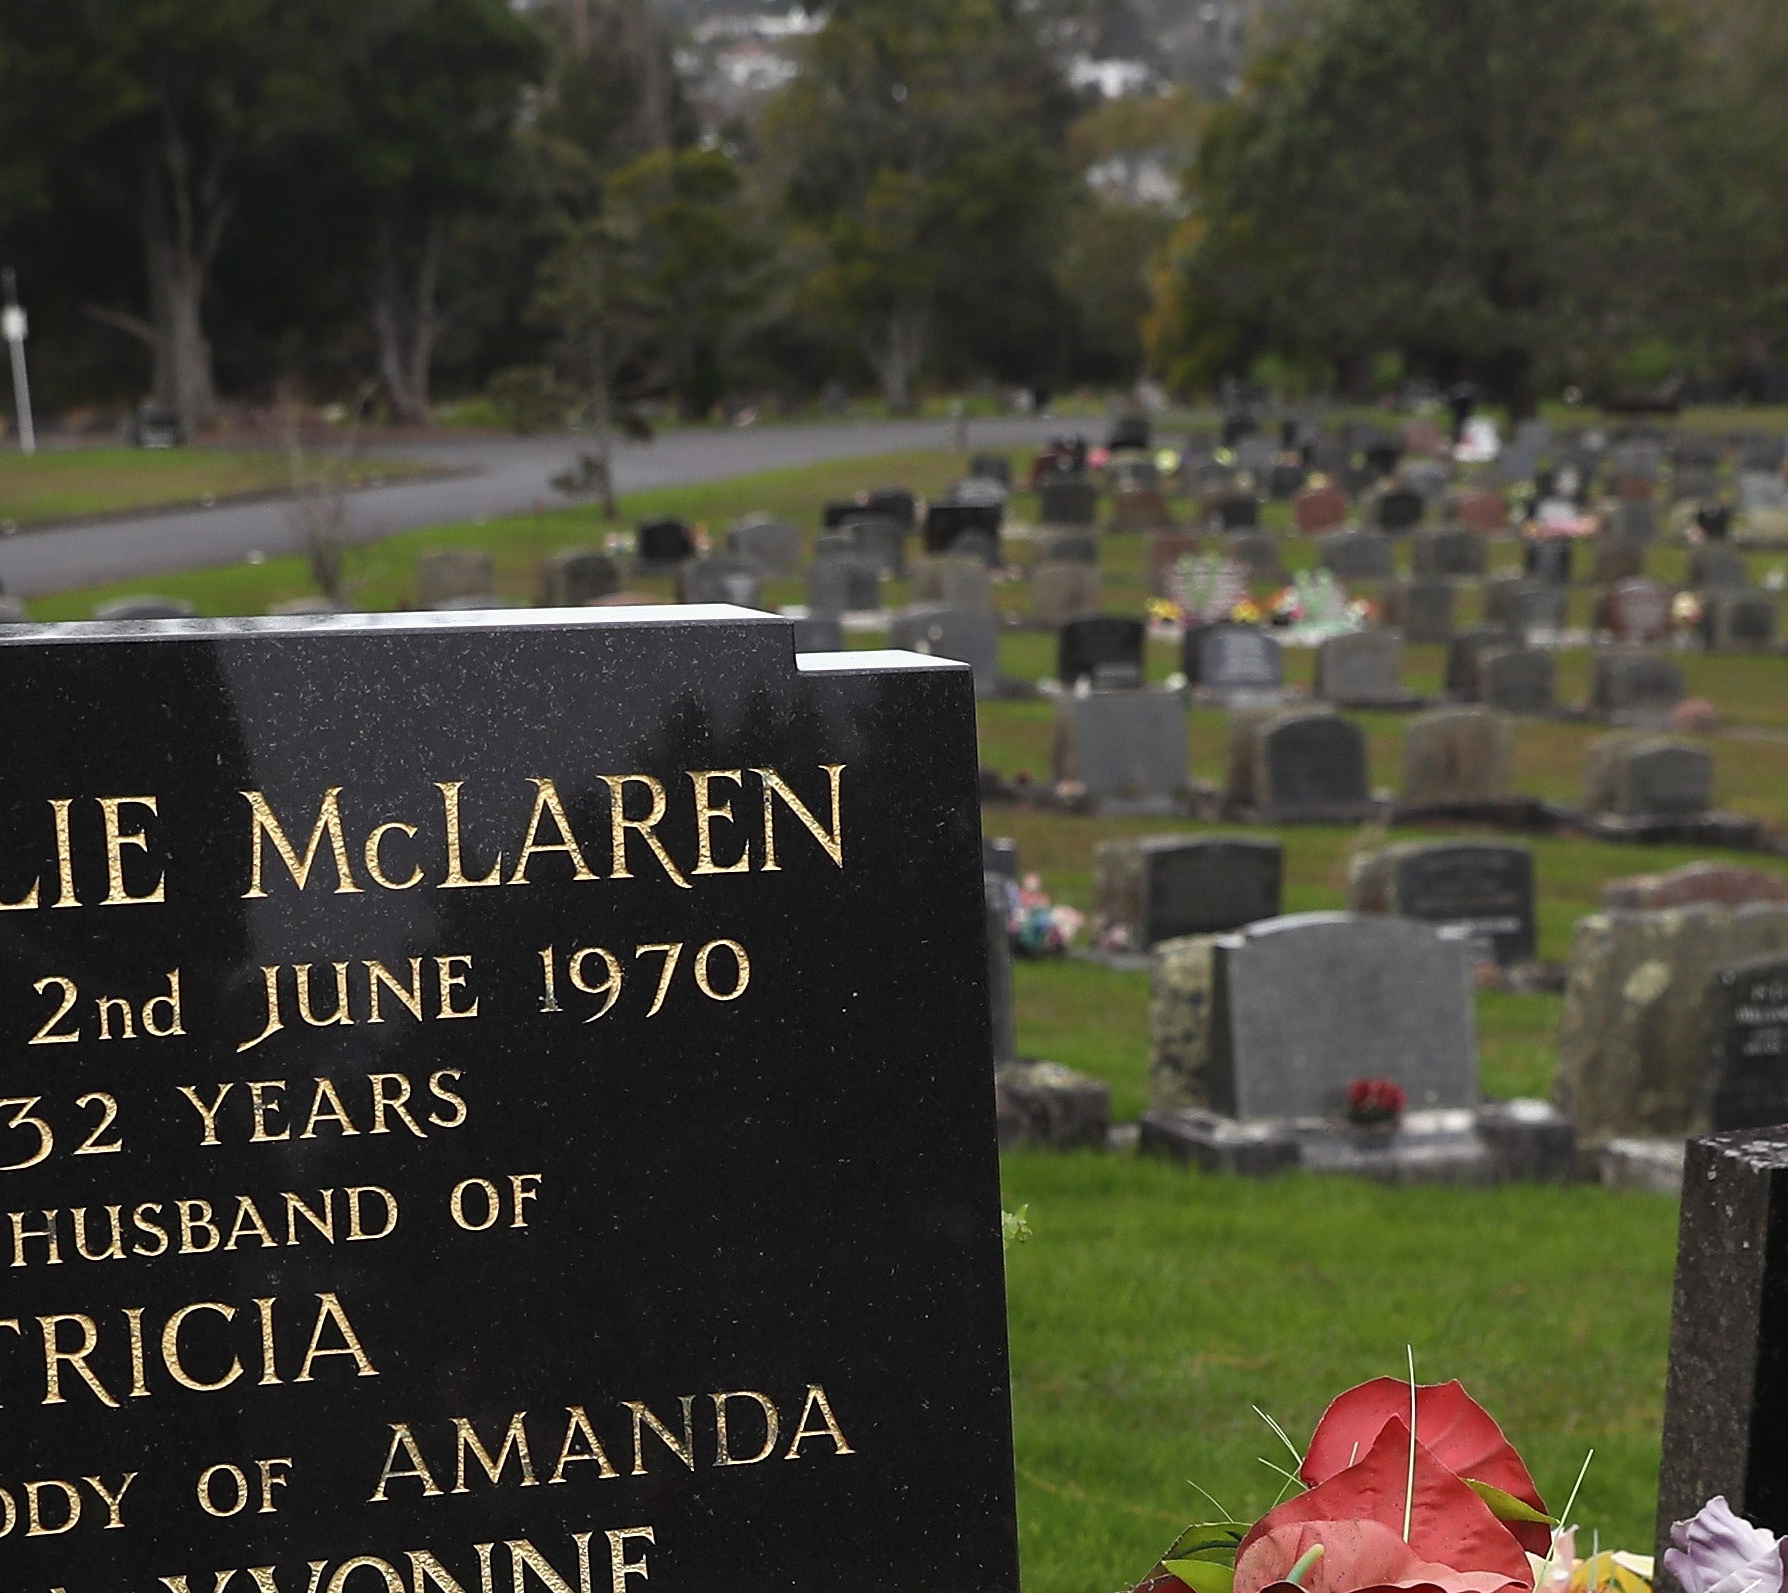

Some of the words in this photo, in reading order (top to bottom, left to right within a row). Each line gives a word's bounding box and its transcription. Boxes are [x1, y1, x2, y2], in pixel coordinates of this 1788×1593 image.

[239, 765, 846, 898] McLAREN
[28, 968, 186, 1044] 2nd
[237, 955, 478, 1053] JUNE
[538, 940, 749, 1023] 1970
[176, 1070, 467, 1145] YEARS
[7, 1187, 397, 1267] HUSBAND
[451, 1174, 541, 1230] OF
[197, 1458, 292, 1516] OF
[369, 1390, 855, 1501] AMANDA
